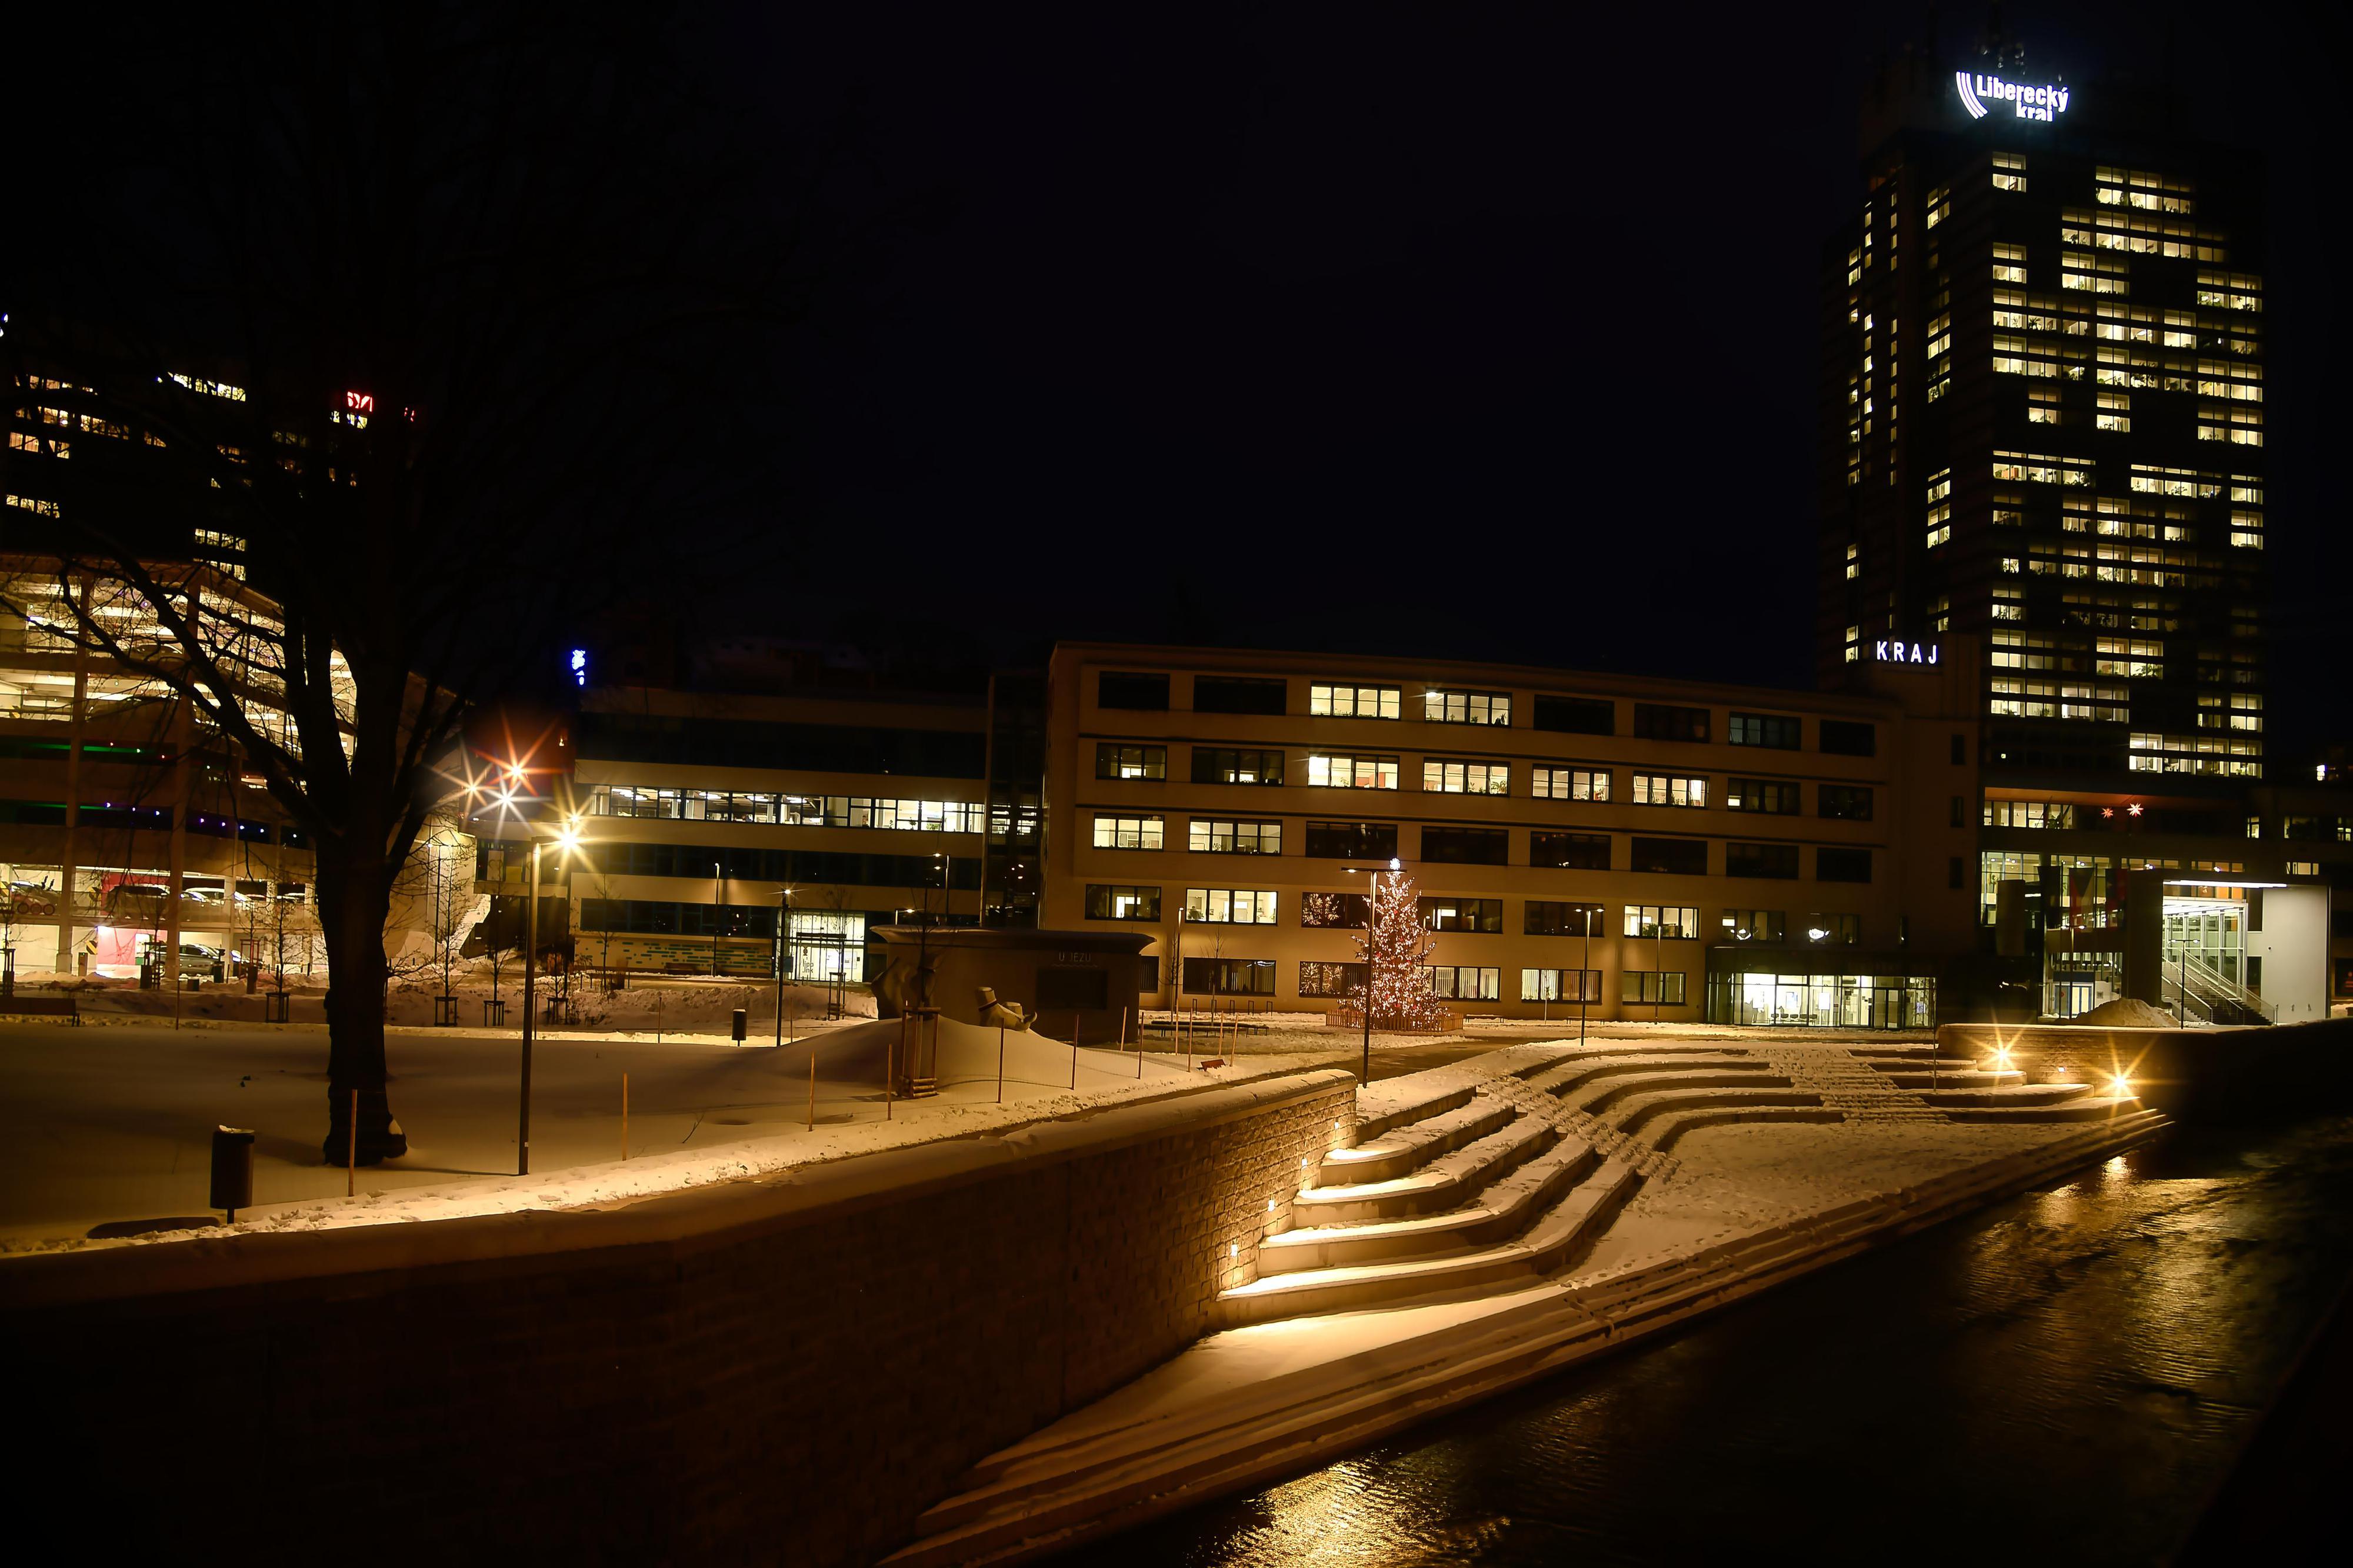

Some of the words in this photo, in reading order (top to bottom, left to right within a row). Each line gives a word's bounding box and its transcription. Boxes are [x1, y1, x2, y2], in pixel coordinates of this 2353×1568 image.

[1977, 74, 2069, 112] Liberecký
[1877, 640, 1937, 664] KRAJ
[1059, 951, 1065, 962] U
